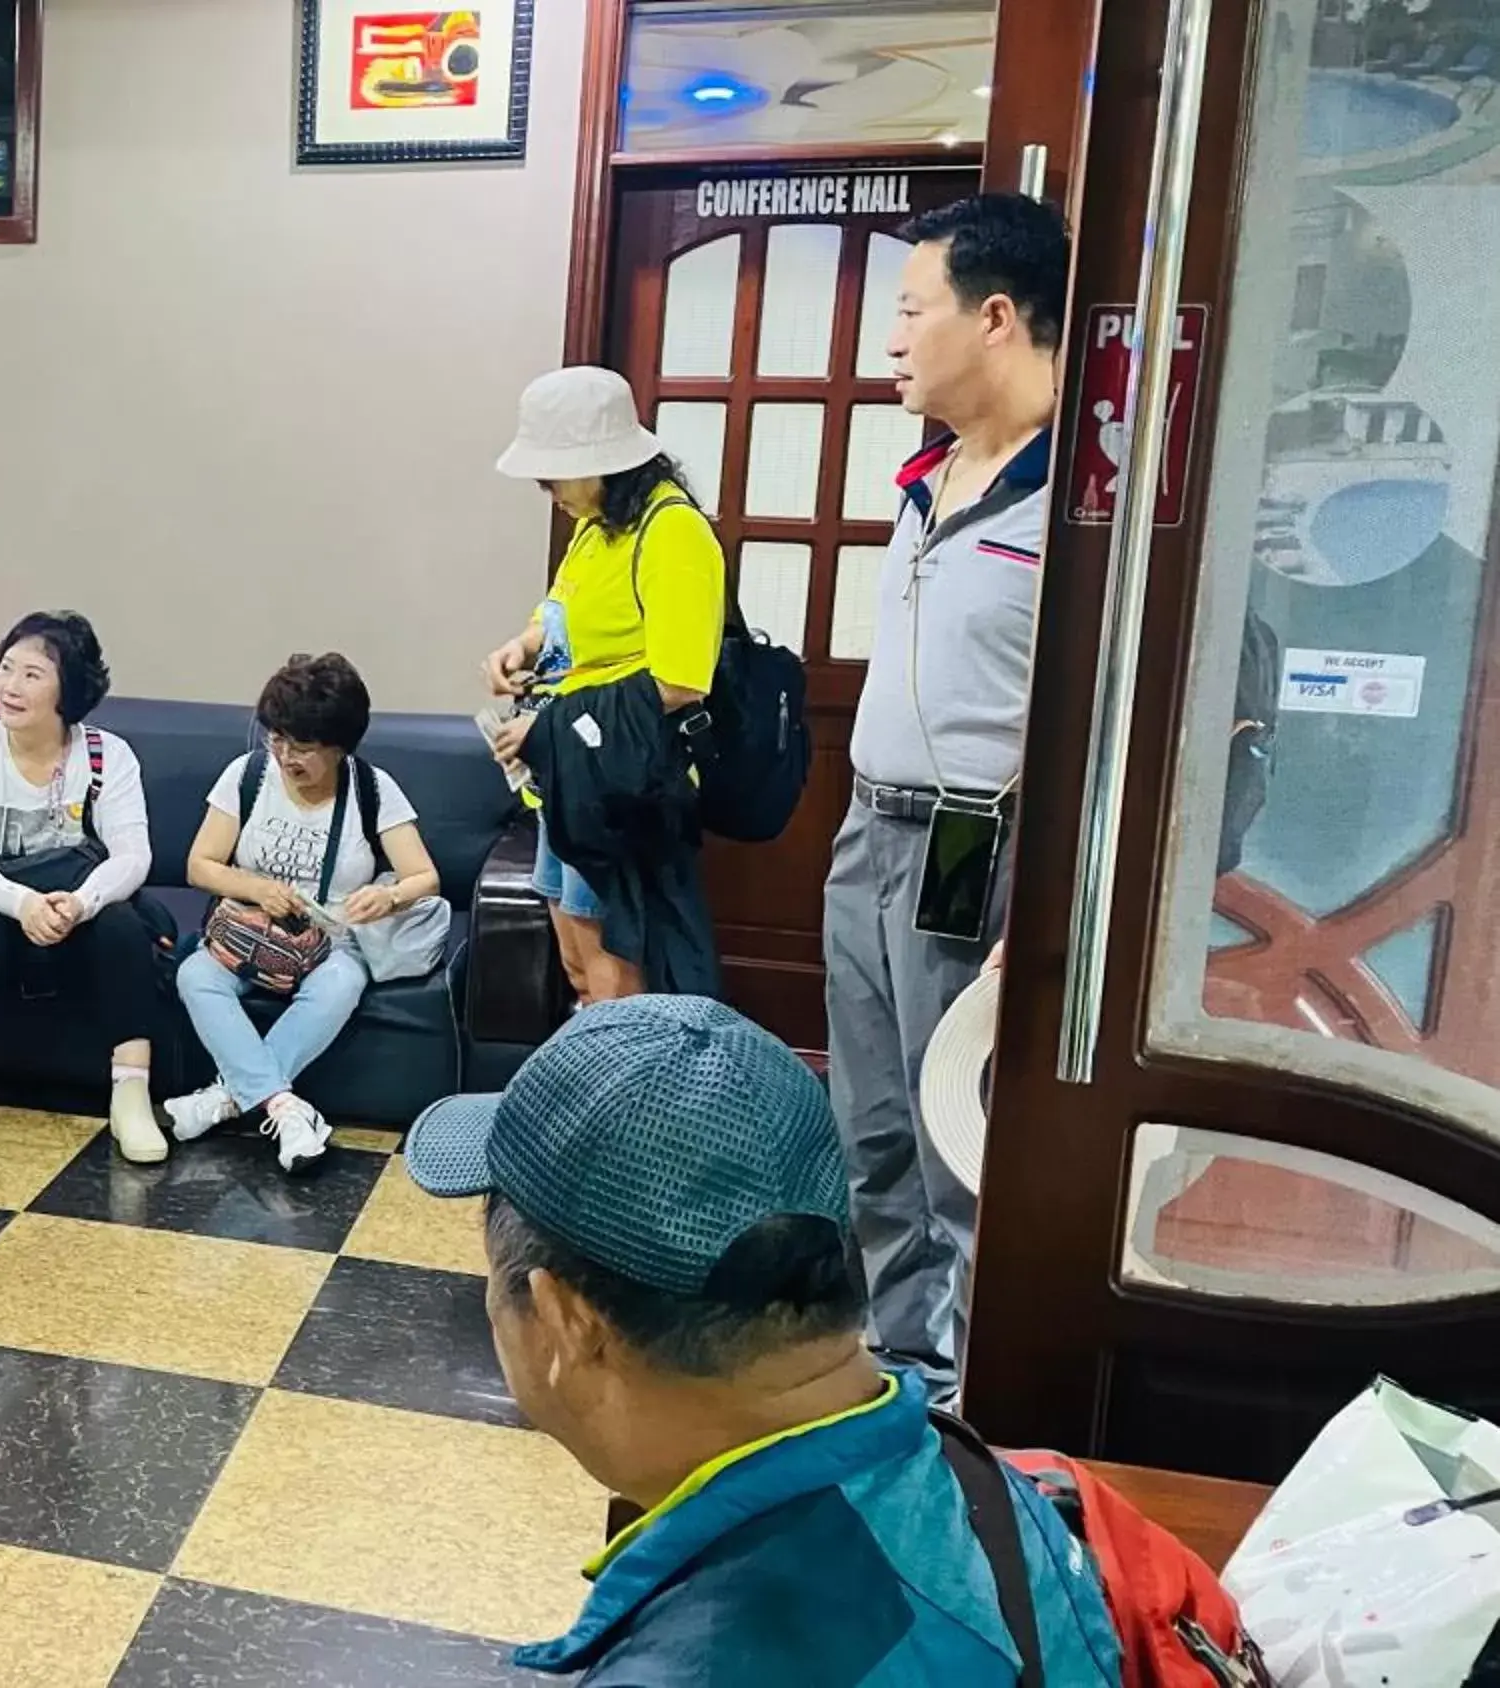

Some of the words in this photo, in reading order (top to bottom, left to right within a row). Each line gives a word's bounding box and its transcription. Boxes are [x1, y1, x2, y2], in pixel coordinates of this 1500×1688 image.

[697, 177, 849, 217] CONFERENCE
[851, 175, 911, 213] HALL
[1096, 314, 1194, 350] PUL
[1299, 683, 1337, 697] VISA
